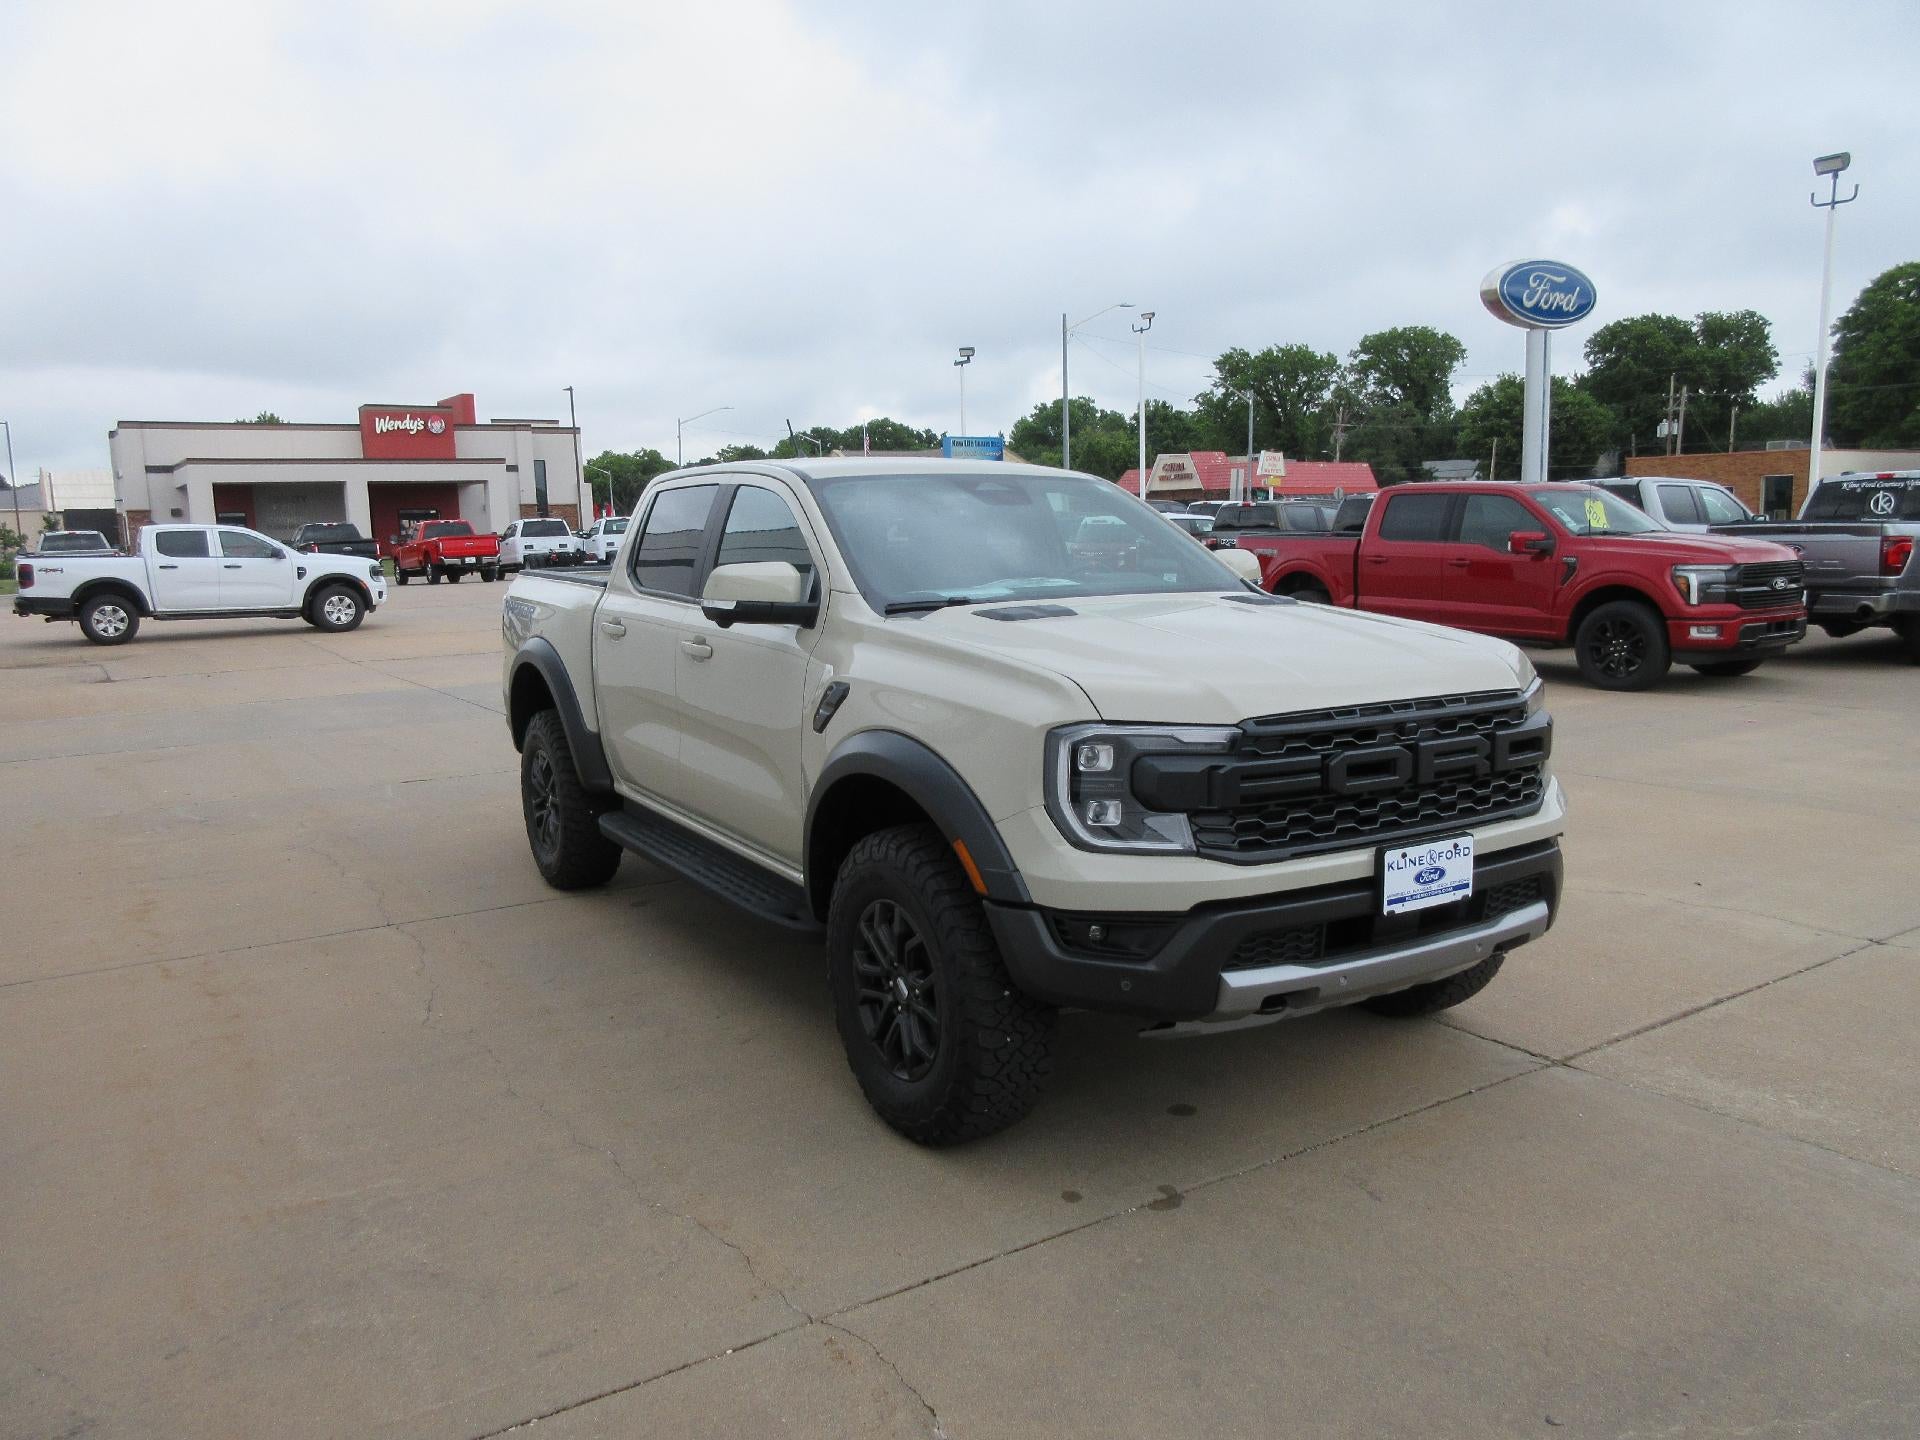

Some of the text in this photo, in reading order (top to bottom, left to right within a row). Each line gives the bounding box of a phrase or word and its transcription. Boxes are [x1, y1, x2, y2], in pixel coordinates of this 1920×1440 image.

[1522, 271, 1580, 312] Ford
[375, 413, 425, 435] Wendy's
[1387, 855, 1426, 872] KLINE
[1437, 846, 1471, 862] FORD
[1419, 868, 1440, 883] Ford
